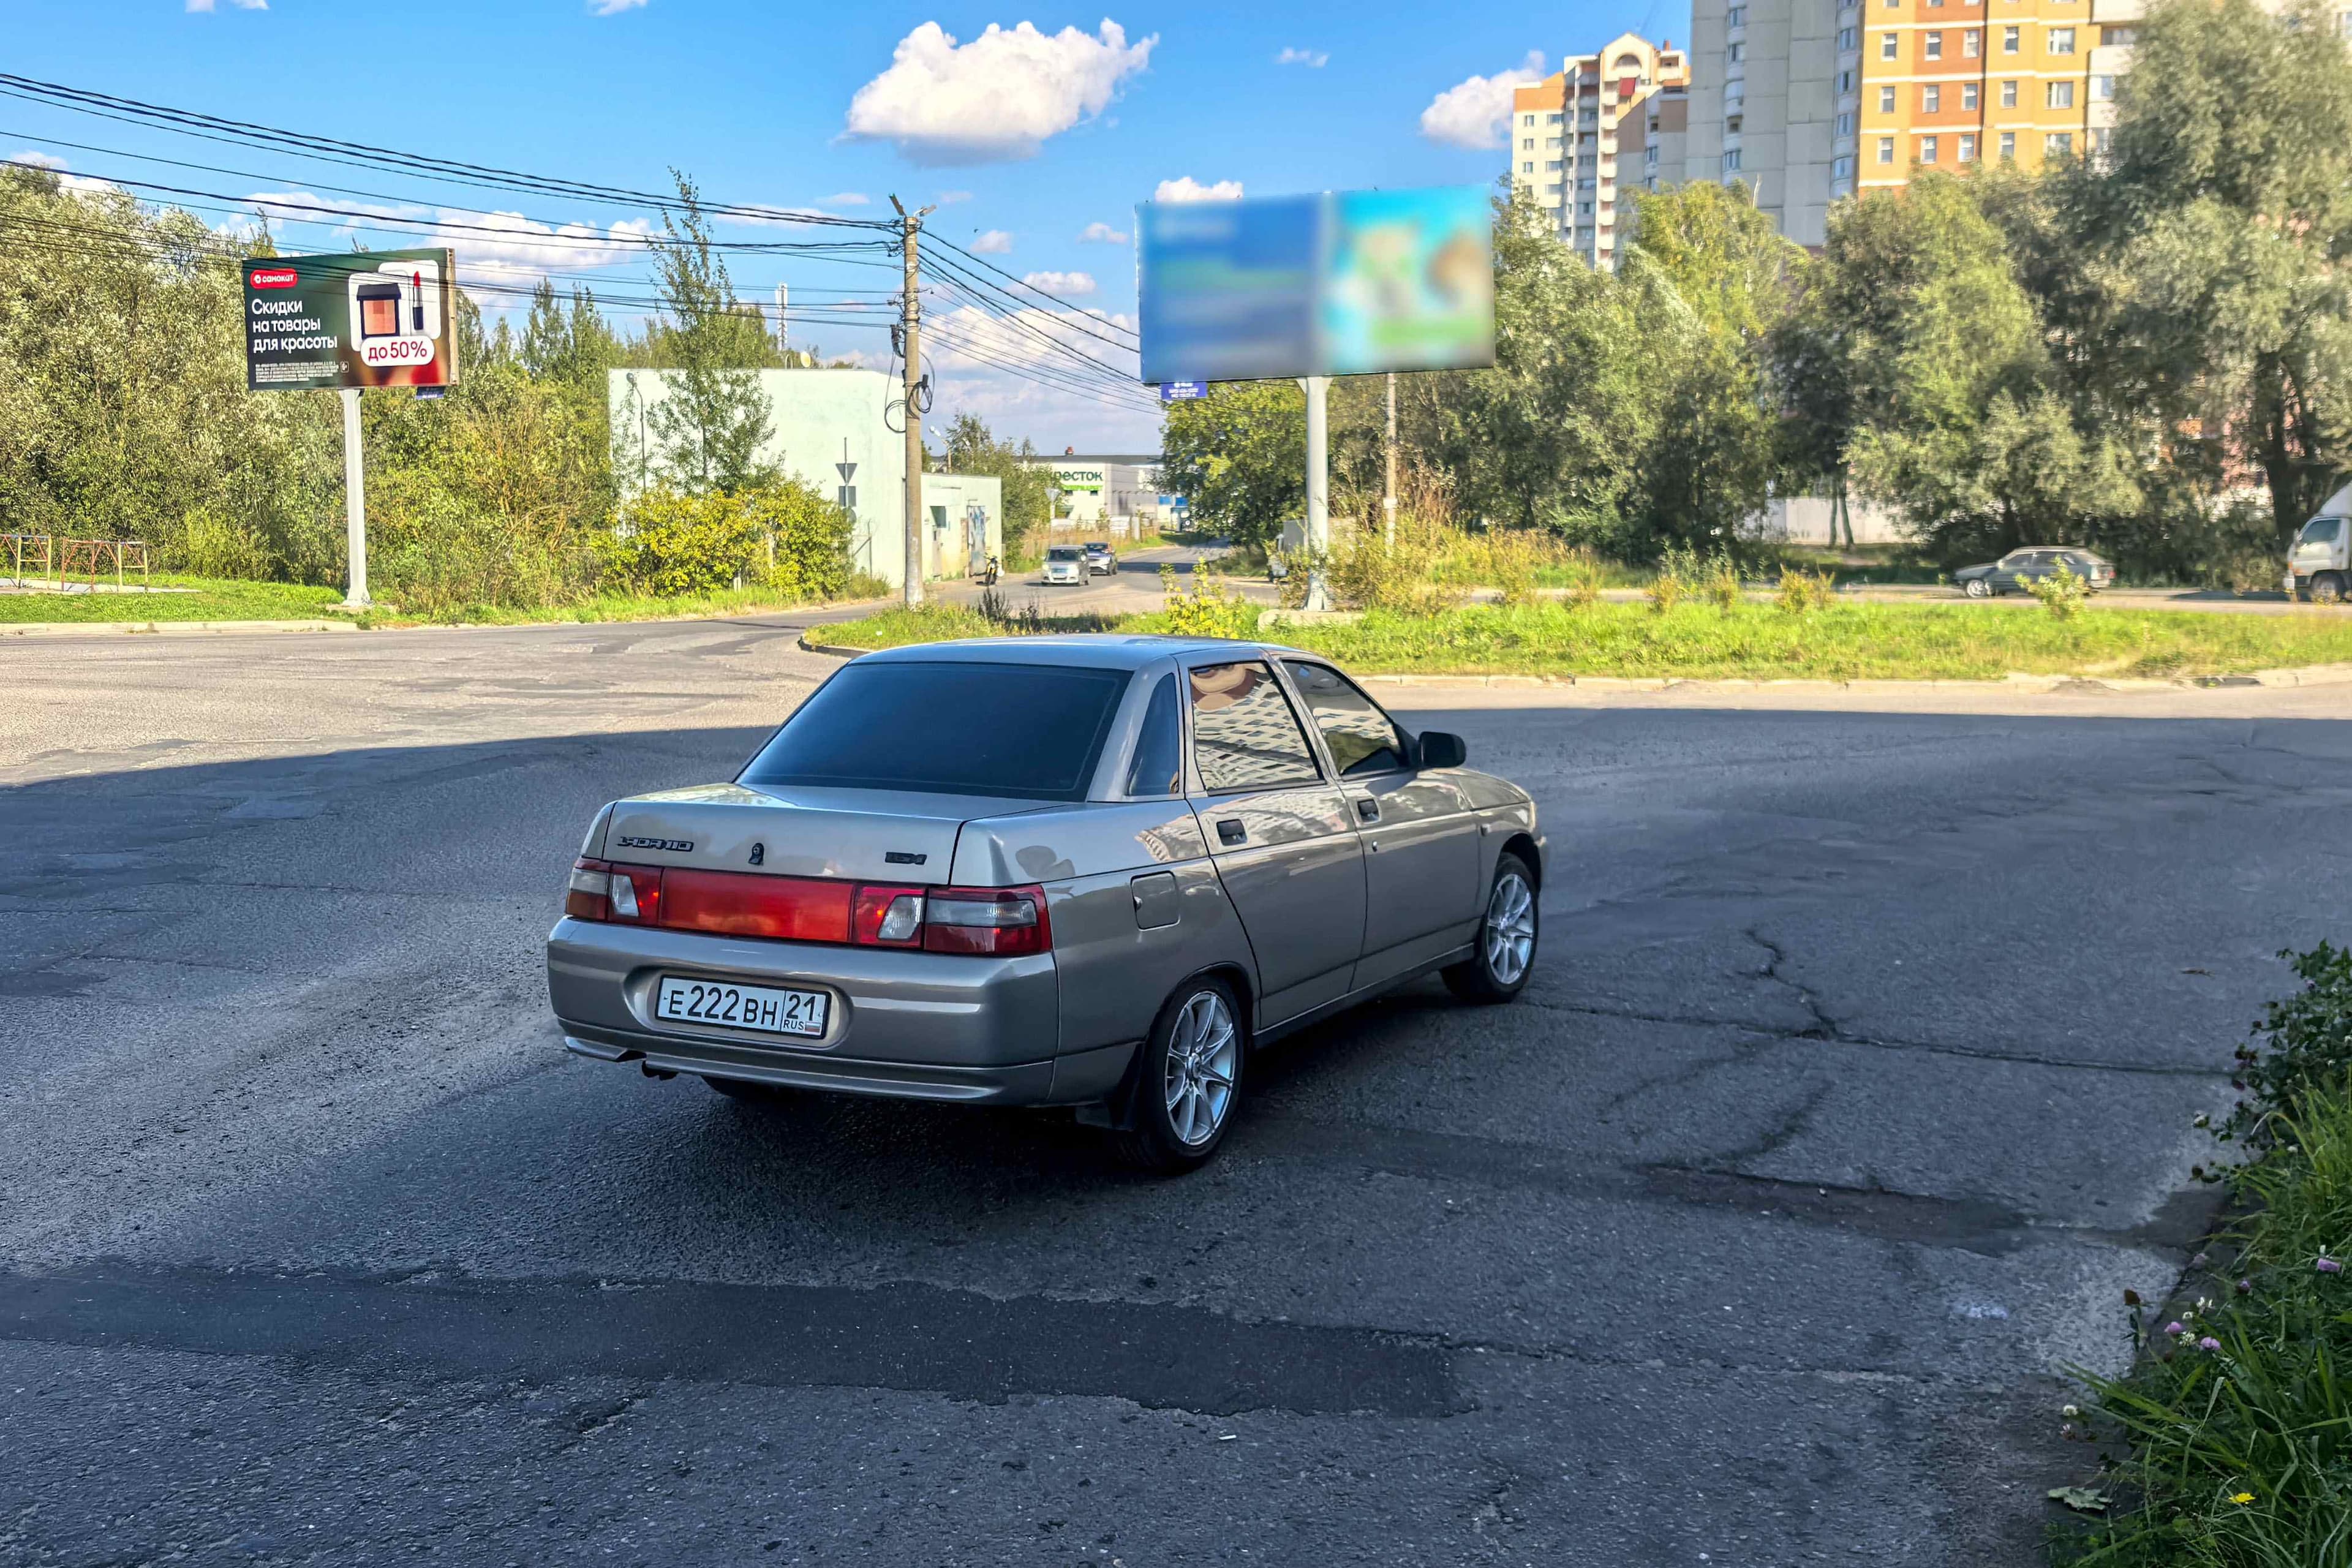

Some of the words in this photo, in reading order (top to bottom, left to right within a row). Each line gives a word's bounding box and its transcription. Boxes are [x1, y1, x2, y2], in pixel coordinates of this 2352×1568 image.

[262, 274, 294, 283] самокат
[251, 298, 303, 315] Скидки
[252, 320, 270, 333] на
[271, 318, 321, 335] товары
[253, 337, 278, 353] для
[281, 336, 337, 354] красоты
[368, 347, 388, 362] до
[390, 341, 428, 358] 50%
[1053, 471, 1103, 481] ресток
[786, 994, 816, 1022] 21
[783, 1019, 804, 1030] RUS
